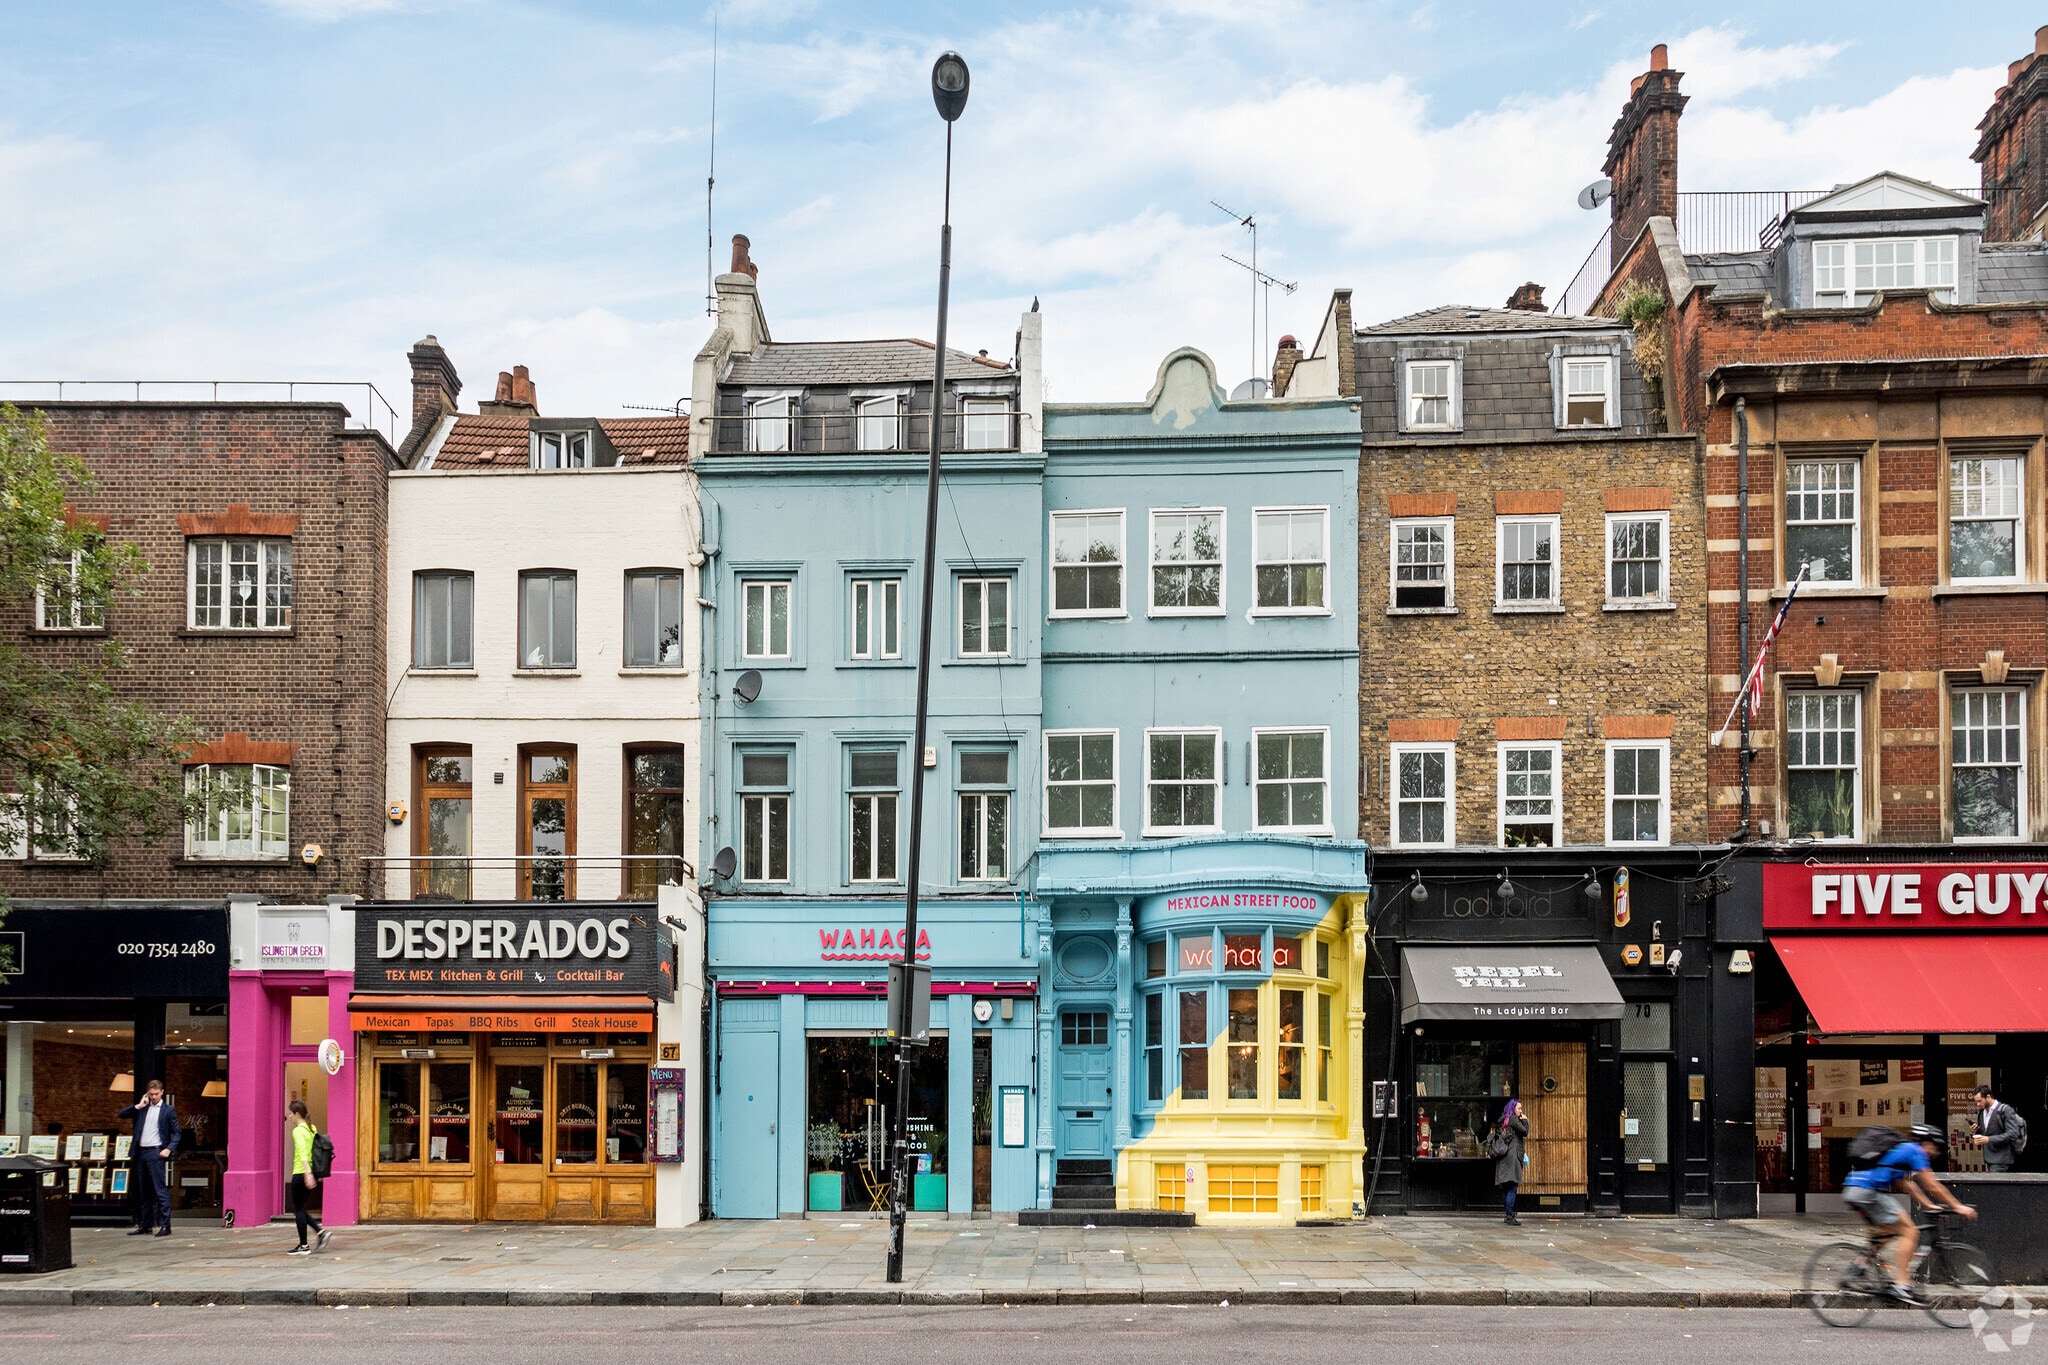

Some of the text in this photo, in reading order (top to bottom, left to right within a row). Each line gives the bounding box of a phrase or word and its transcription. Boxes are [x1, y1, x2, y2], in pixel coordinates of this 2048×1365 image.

[1812, 873, 2048, 915] FIVE GUY
[1167, 893, 1317, 911] MEXICAN STREET FOOD
[376, 918, 630, 960] DESPERADOS
[118, 940, 216, 958] 020 7354 2480
[261, 945, 323, 956] ISLINGTON GREEN
[386, 970, 523, 982] TEX MEX Kitchen & Grill
[556, 970, 624, 982] Cocktail Bar
[1452, 966, 1564, 978] REBEL
[1456, 977, 1527, 988] YELL
[1474, 1006, 1569, 1016] The Ladybird Bar
[1635, 1004, 1651, 1018] 70
[366, 1016, 638, 1030] Mexican Tapas BBQ Ribs Grill Steak House
[663, 1047, 677, 1058] 67
[651, 1068, 673, 1080] MENU
[1627, 1123, 1636, 1131] 70
